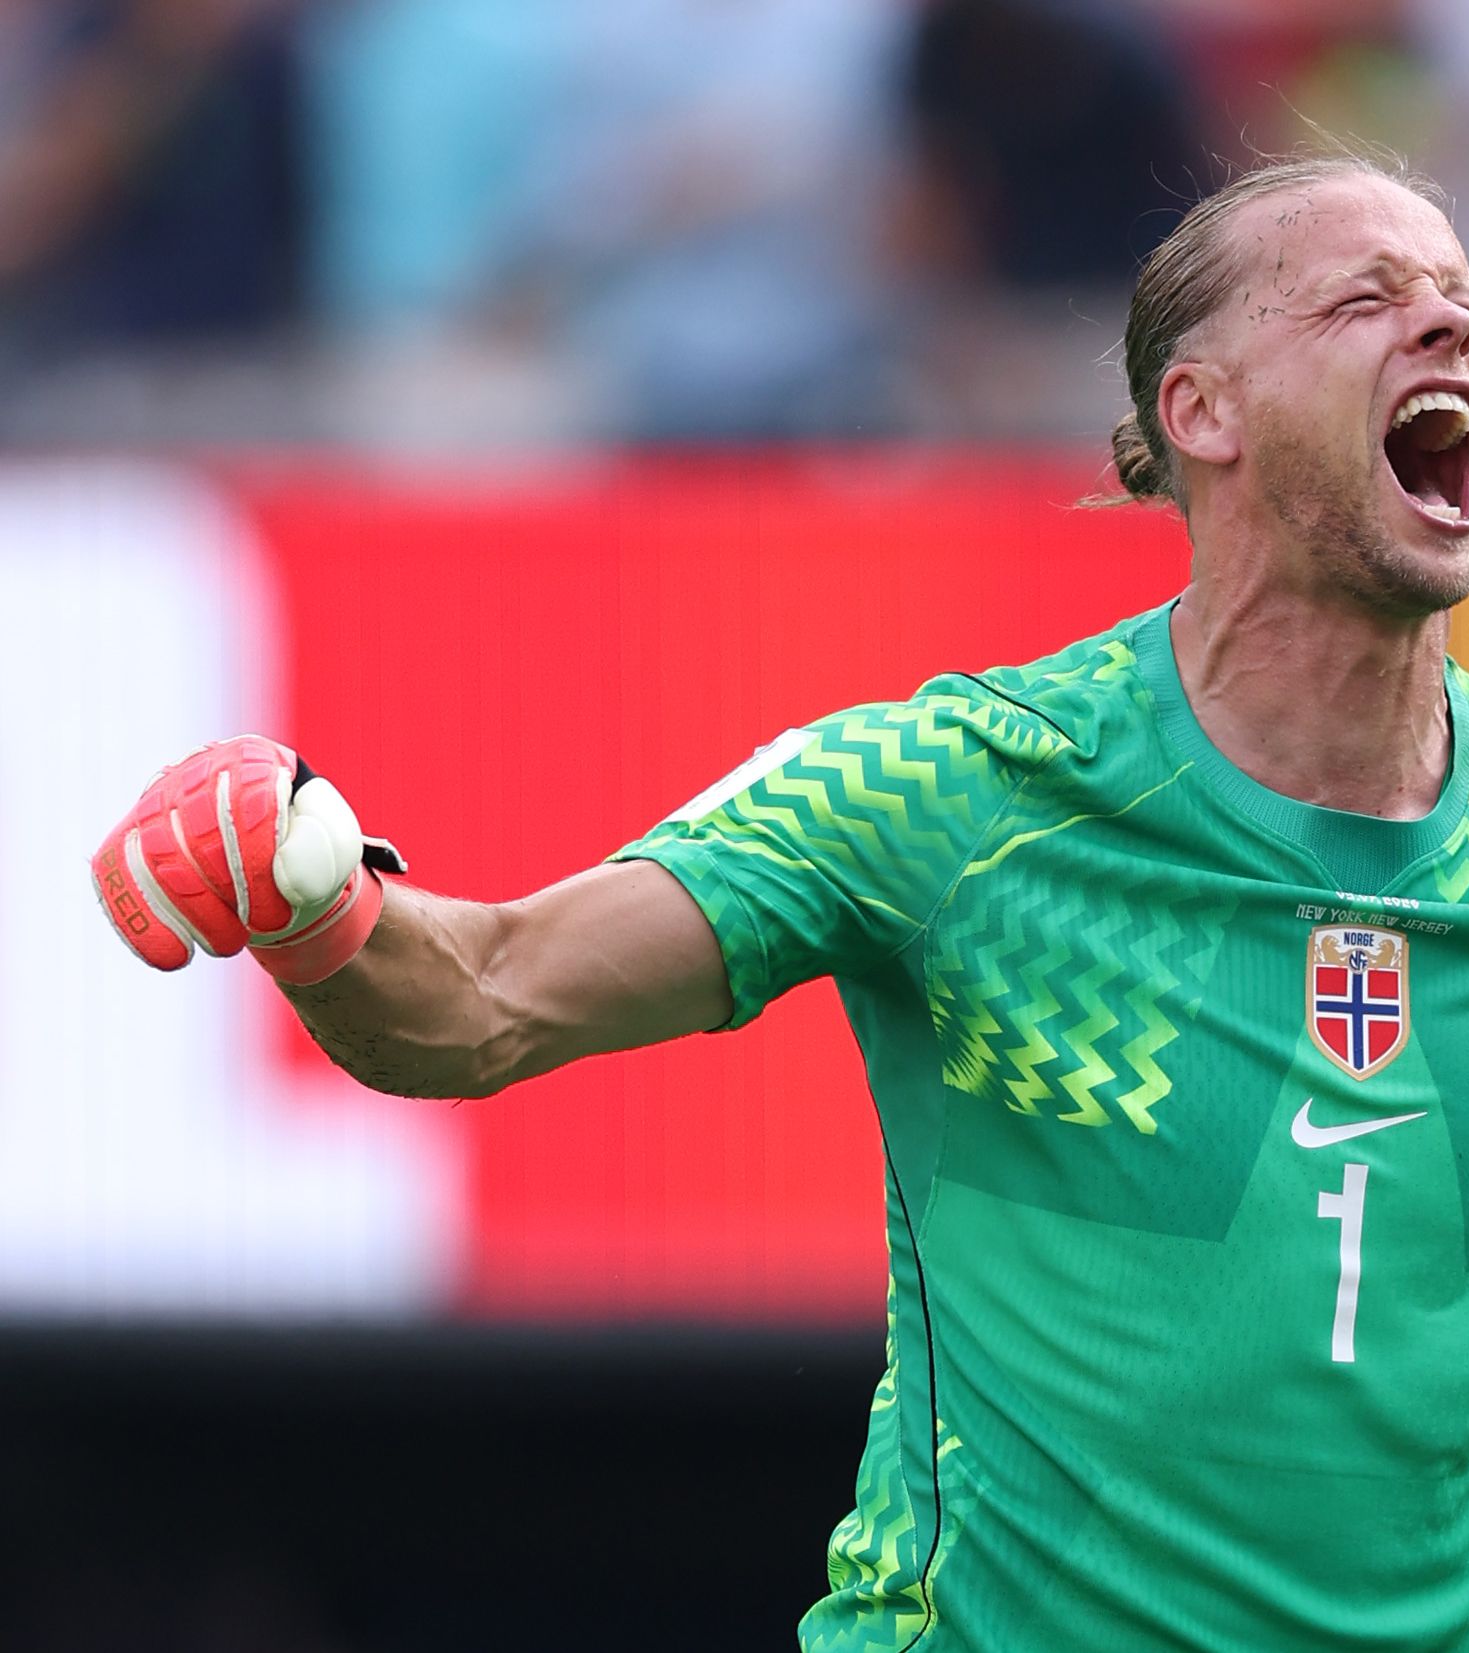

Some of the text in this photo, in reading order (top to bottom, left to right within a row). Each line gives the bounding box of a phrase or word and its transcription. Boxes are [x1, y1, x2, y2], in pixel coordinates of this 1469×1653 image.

[101, 847, 150, 935] PRED
[1296, 903, 1454, 936] NEW YORK NEW JERSEY
[1343, 932, 1375, 947] NORGE
[1317, 1163, 1369, 1362] 1
